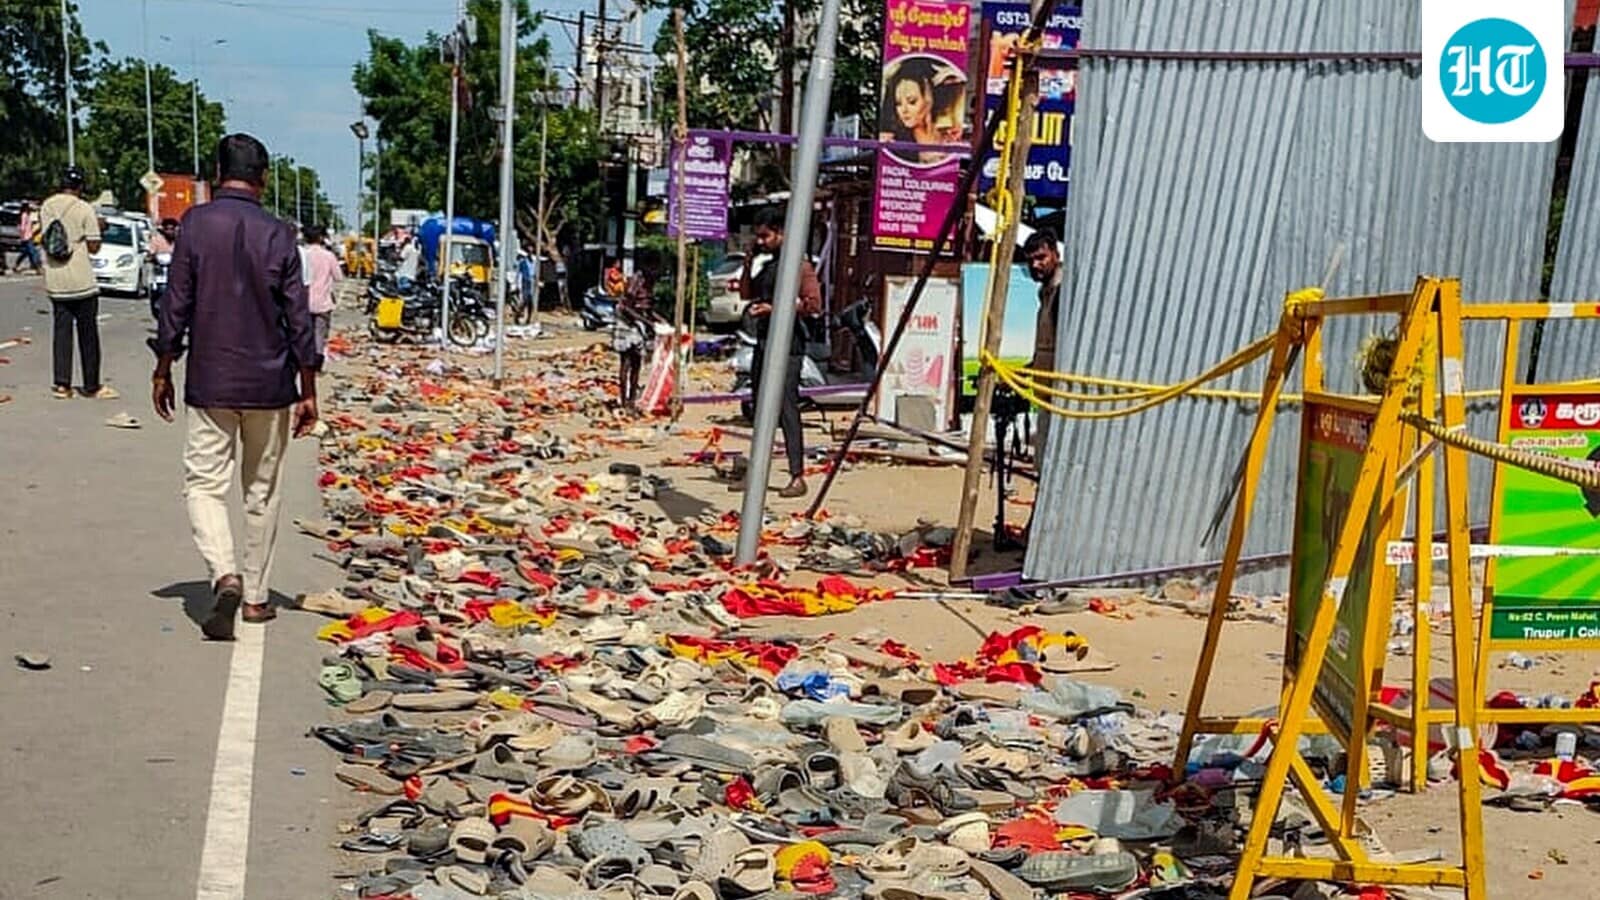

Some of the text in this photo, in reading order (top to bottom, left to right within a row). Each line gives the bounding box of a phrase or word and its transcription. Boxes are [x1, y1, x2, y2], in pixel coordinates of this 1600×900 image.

[882, 166, 912, 177] FACIAL
[904, 178, 954, 192] COLOURING
[880, 188, 927, 201] MANICURE
[880, 199, 923, 212] PEDICURE
[1523, 626, 1566, 639] Tirupur
[1578, 626, 1600, 638] Coi
